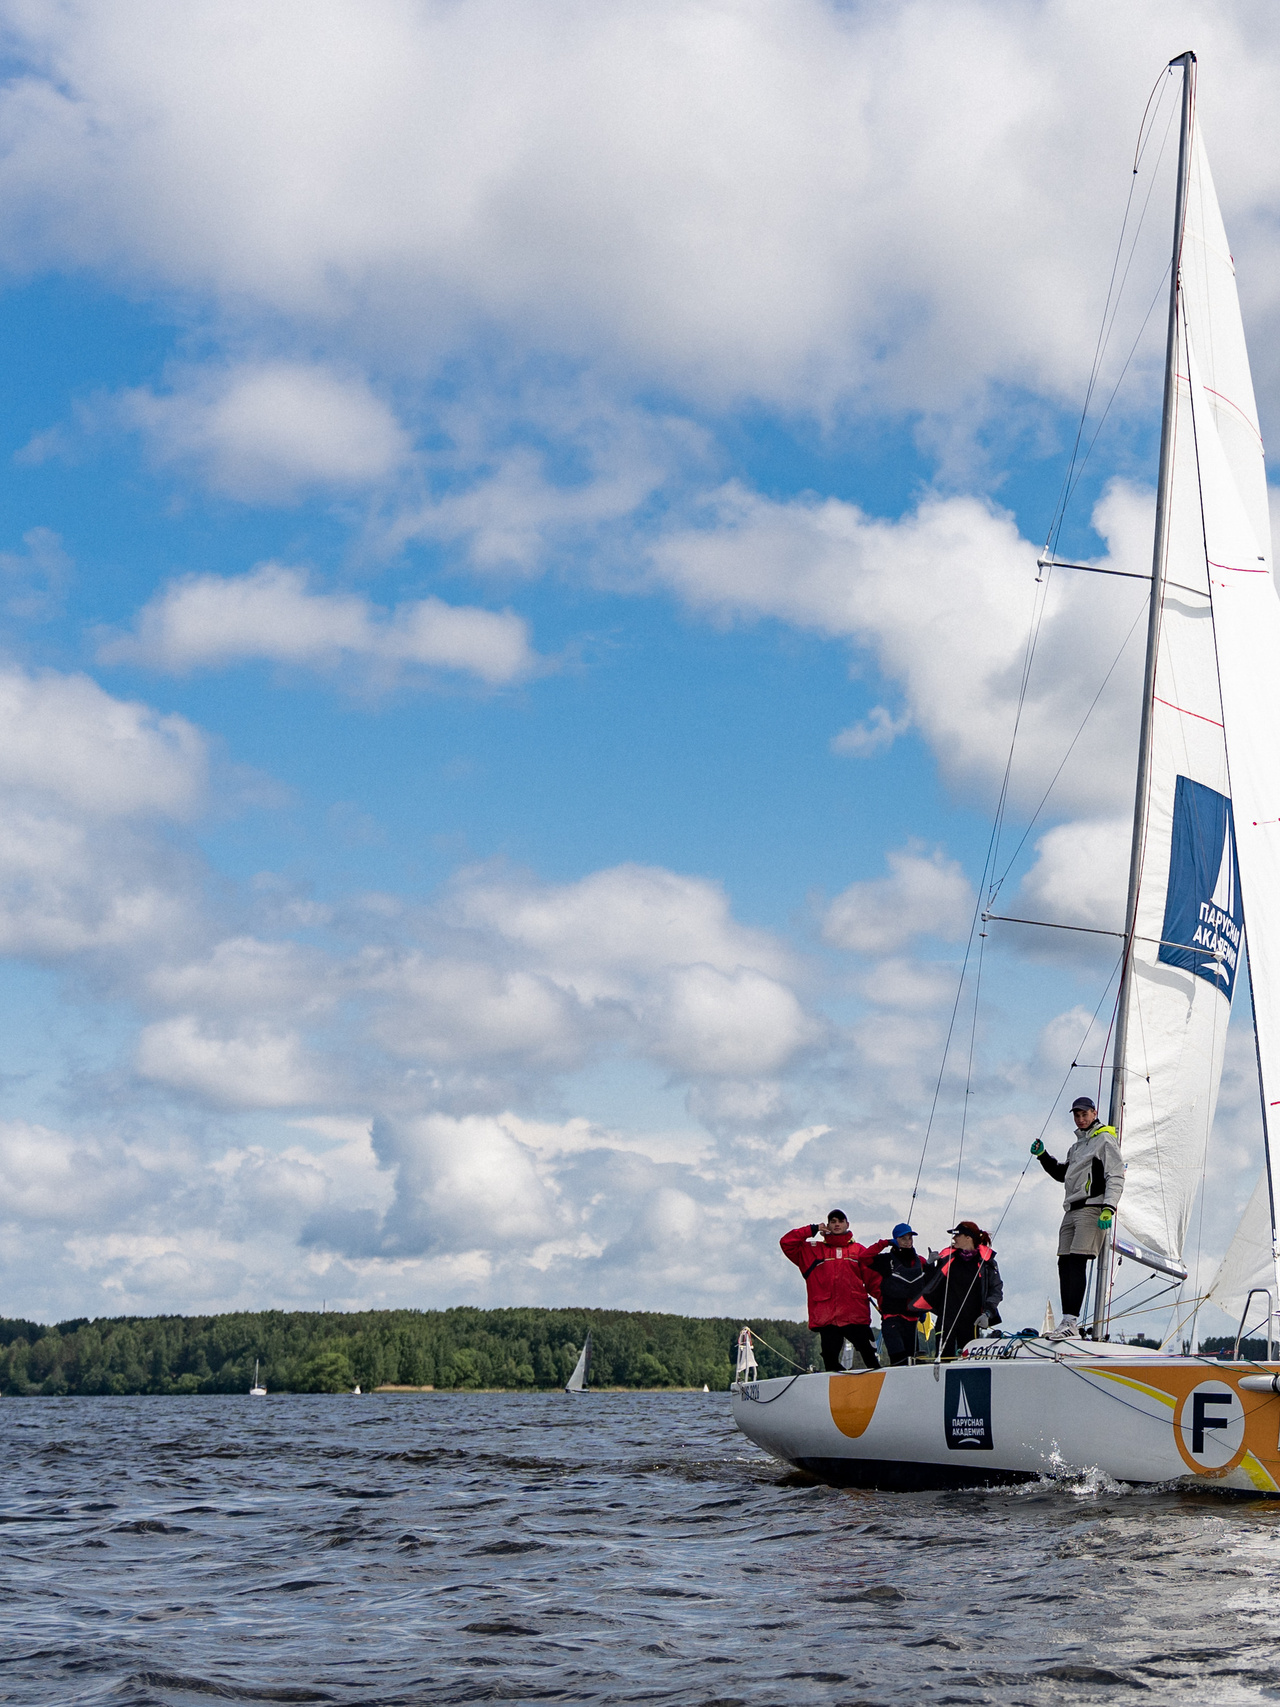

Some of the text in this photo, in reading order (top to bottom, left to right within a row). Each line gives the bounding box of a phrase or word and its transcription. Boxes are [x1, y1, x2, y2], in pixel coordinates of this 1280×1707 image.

[1199, 902, 1240, 949] ПАРУСНАЯ
[952, 1418, 984, 1427] ПАРУСНАЯ
[952, 1428, 985, 1437] АКАДЕМИЯ
[1192, 1392, 1232, 1454] F
